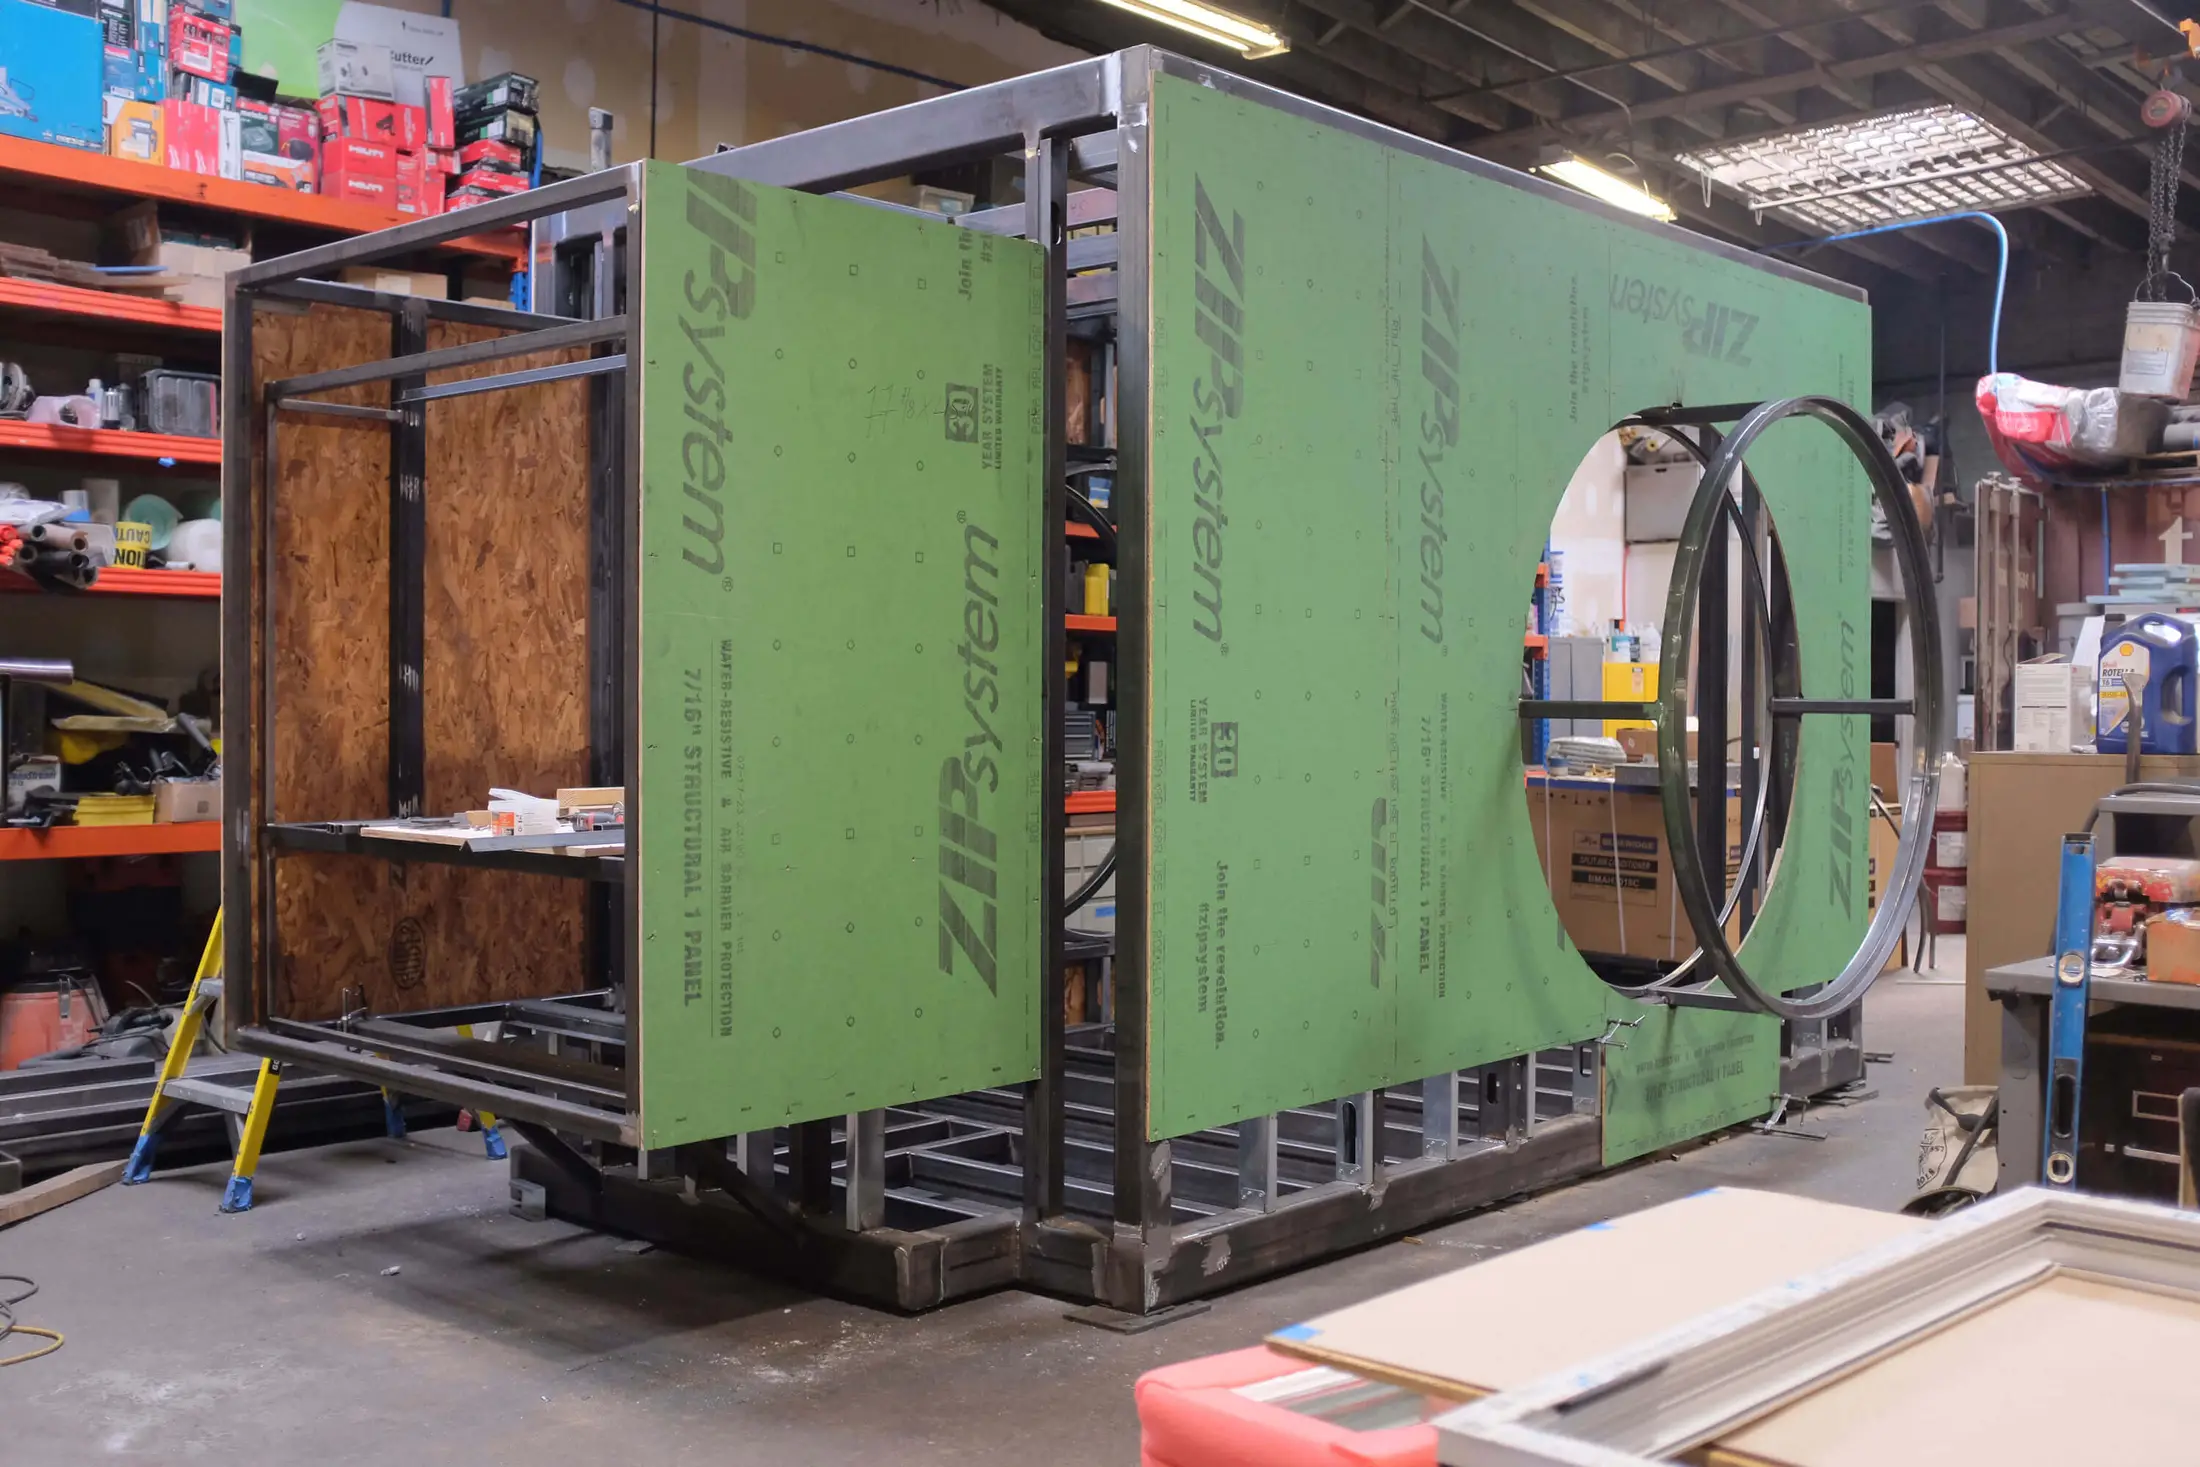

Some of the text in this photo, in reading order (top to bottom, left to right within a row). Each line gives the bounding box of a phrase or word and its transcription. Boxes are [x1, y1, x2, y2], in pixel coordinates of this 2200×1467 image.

[957, 228, 974, 301] Join th
[982, 363, 993, 470] YEAR SYSTEM
[720, 638, 733, 779] WATER-RESISTIVE
[1198, 697, 1209, 804] YEAR SYSTEM
[1213, 726, 1237, 772] 30
[683, 745, 702, 898] STRUCTURAL
[720, 827, 732, 854] AIR
[1419, 775, 1432, 891] STRUCTURAL
[720, 863, 732, 932] BARRIER
[1216, 860, 1228, 902] Join
[1216, 904, 1228, 938] the
[1419, 914, 1432, 974] PANEL
[683, 930, 702, 1007] PANEL
[720, 941, 733, 1037] PROTECTION
[1437, 923, 1448, 999] PROTECTION
